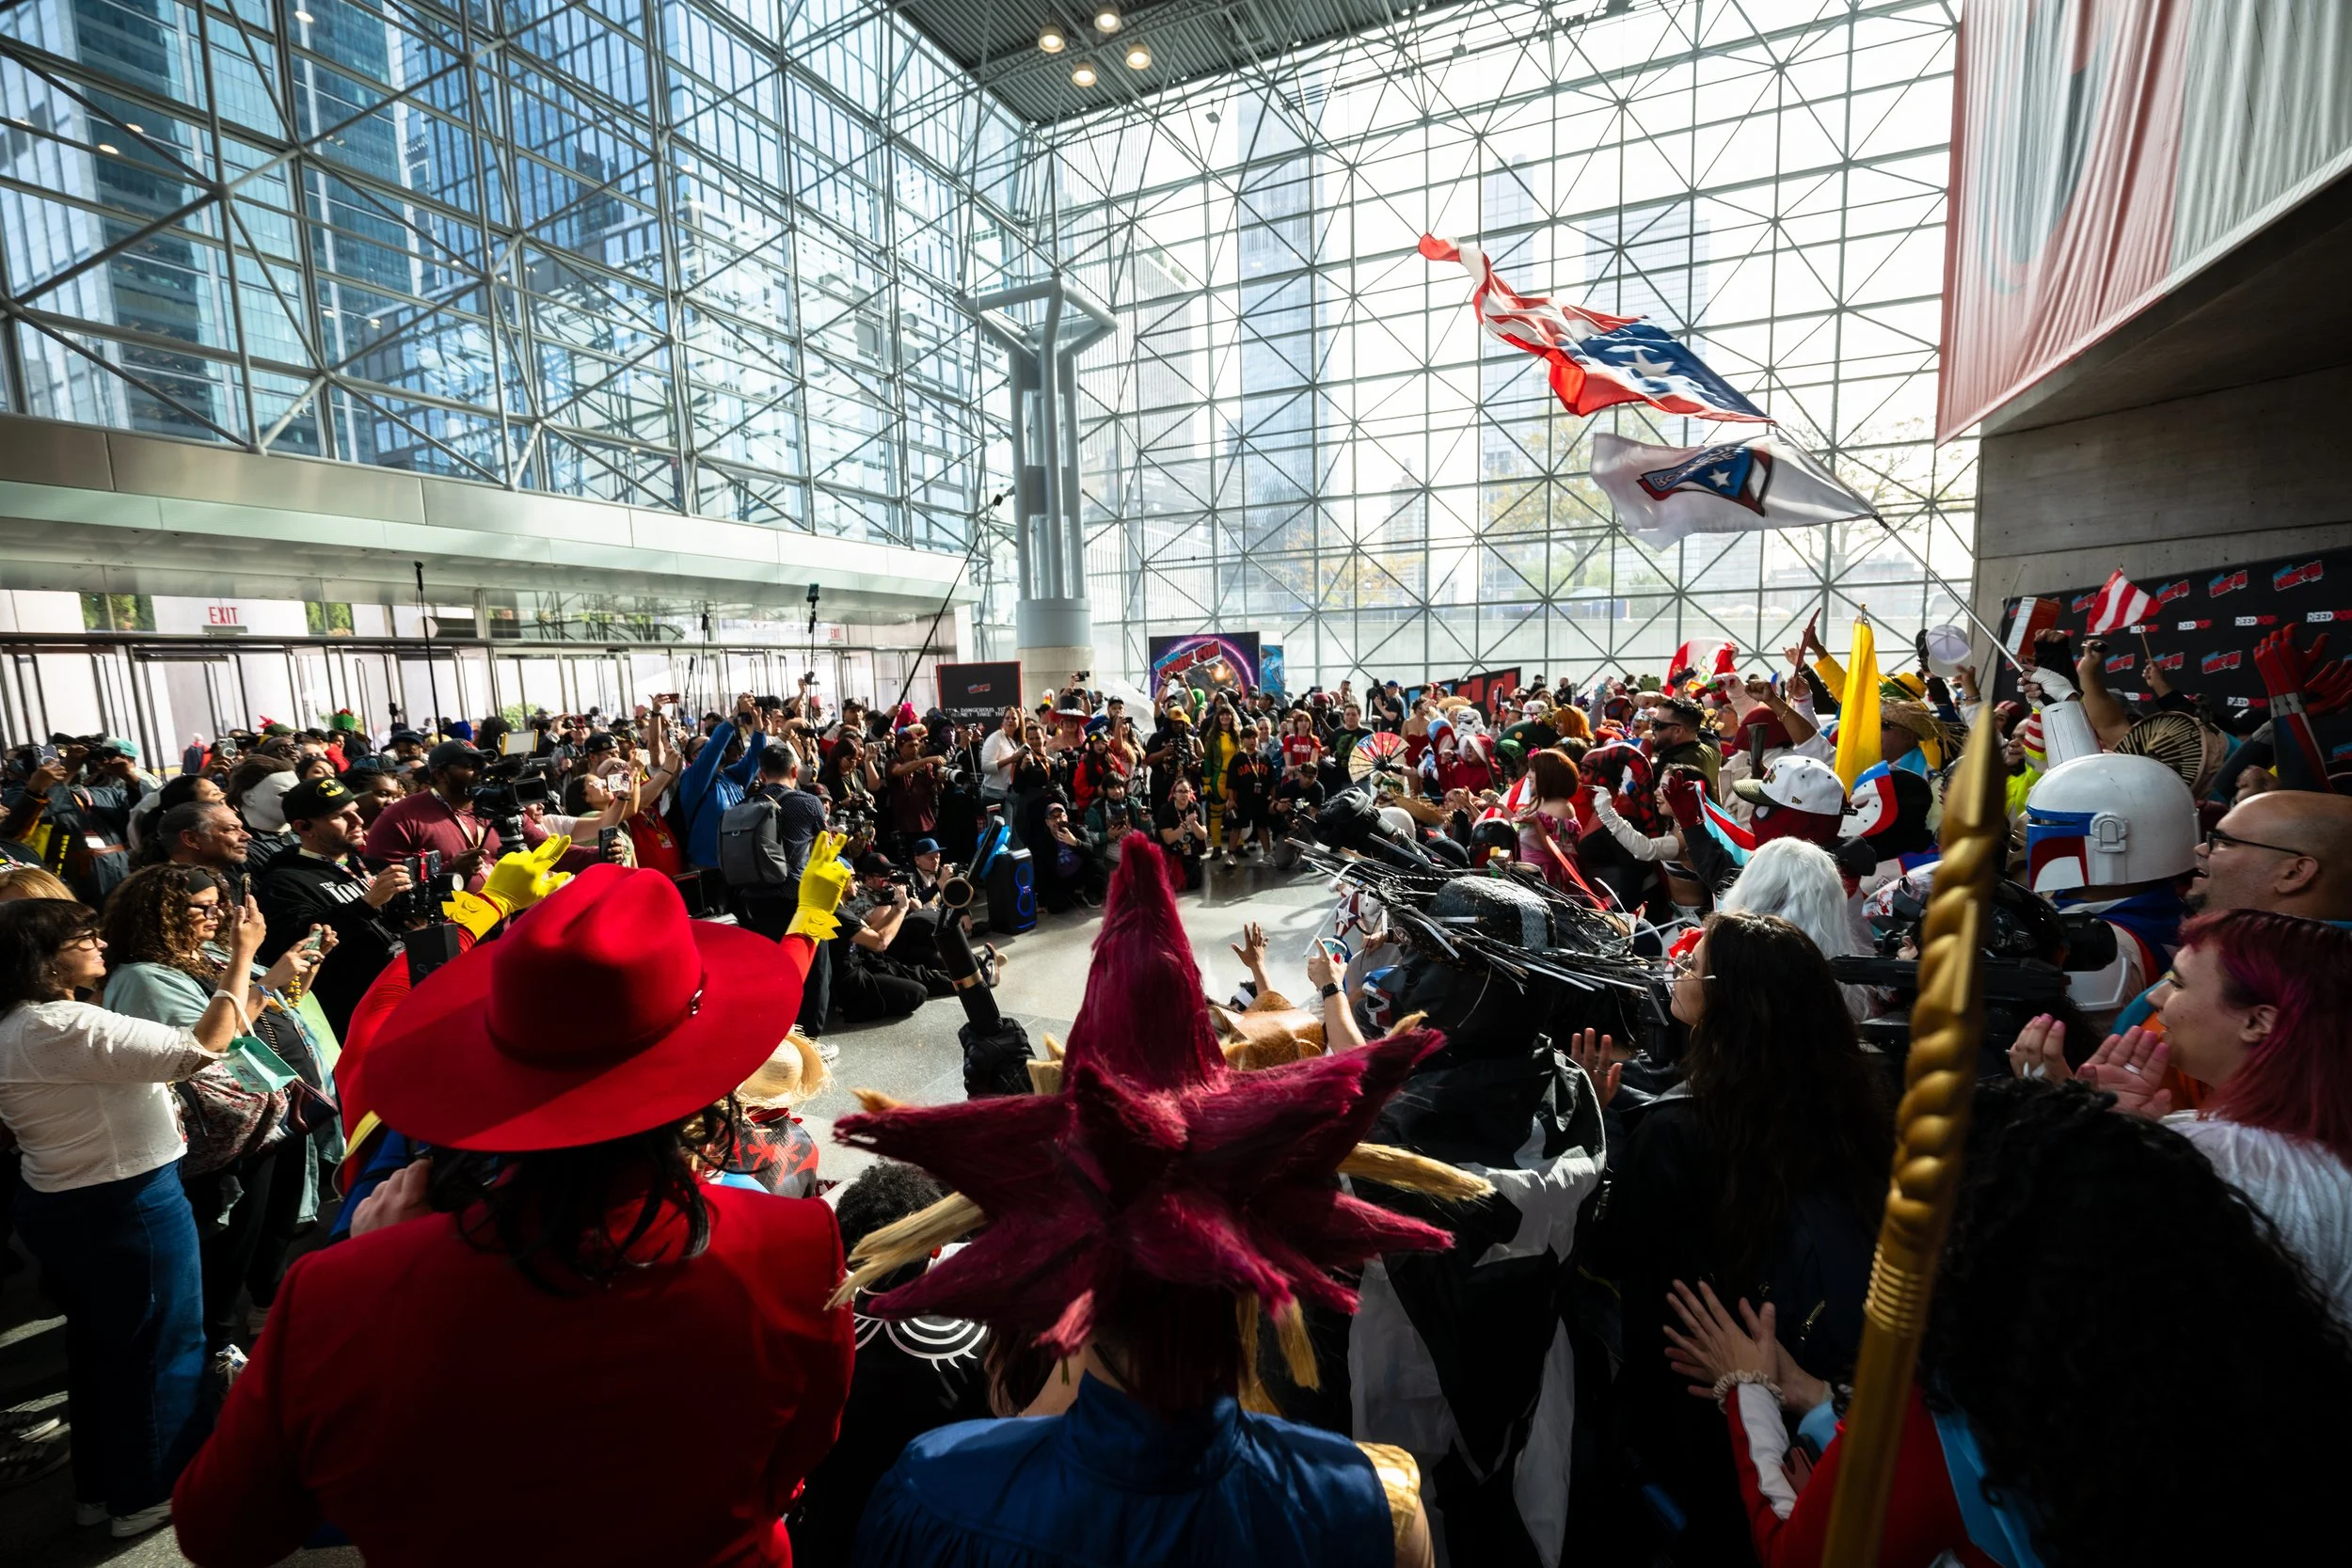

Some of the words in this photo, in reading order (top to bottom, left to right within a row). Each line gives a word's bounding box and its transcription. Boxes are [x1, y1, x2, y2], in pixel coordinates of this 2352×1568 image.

[209, 606, 237, 625] EXIT
[1158, 652, 1195, 677] COMIC
[1195, 641, 1221, 663] CON
[319, 880, 337, 891] THE
